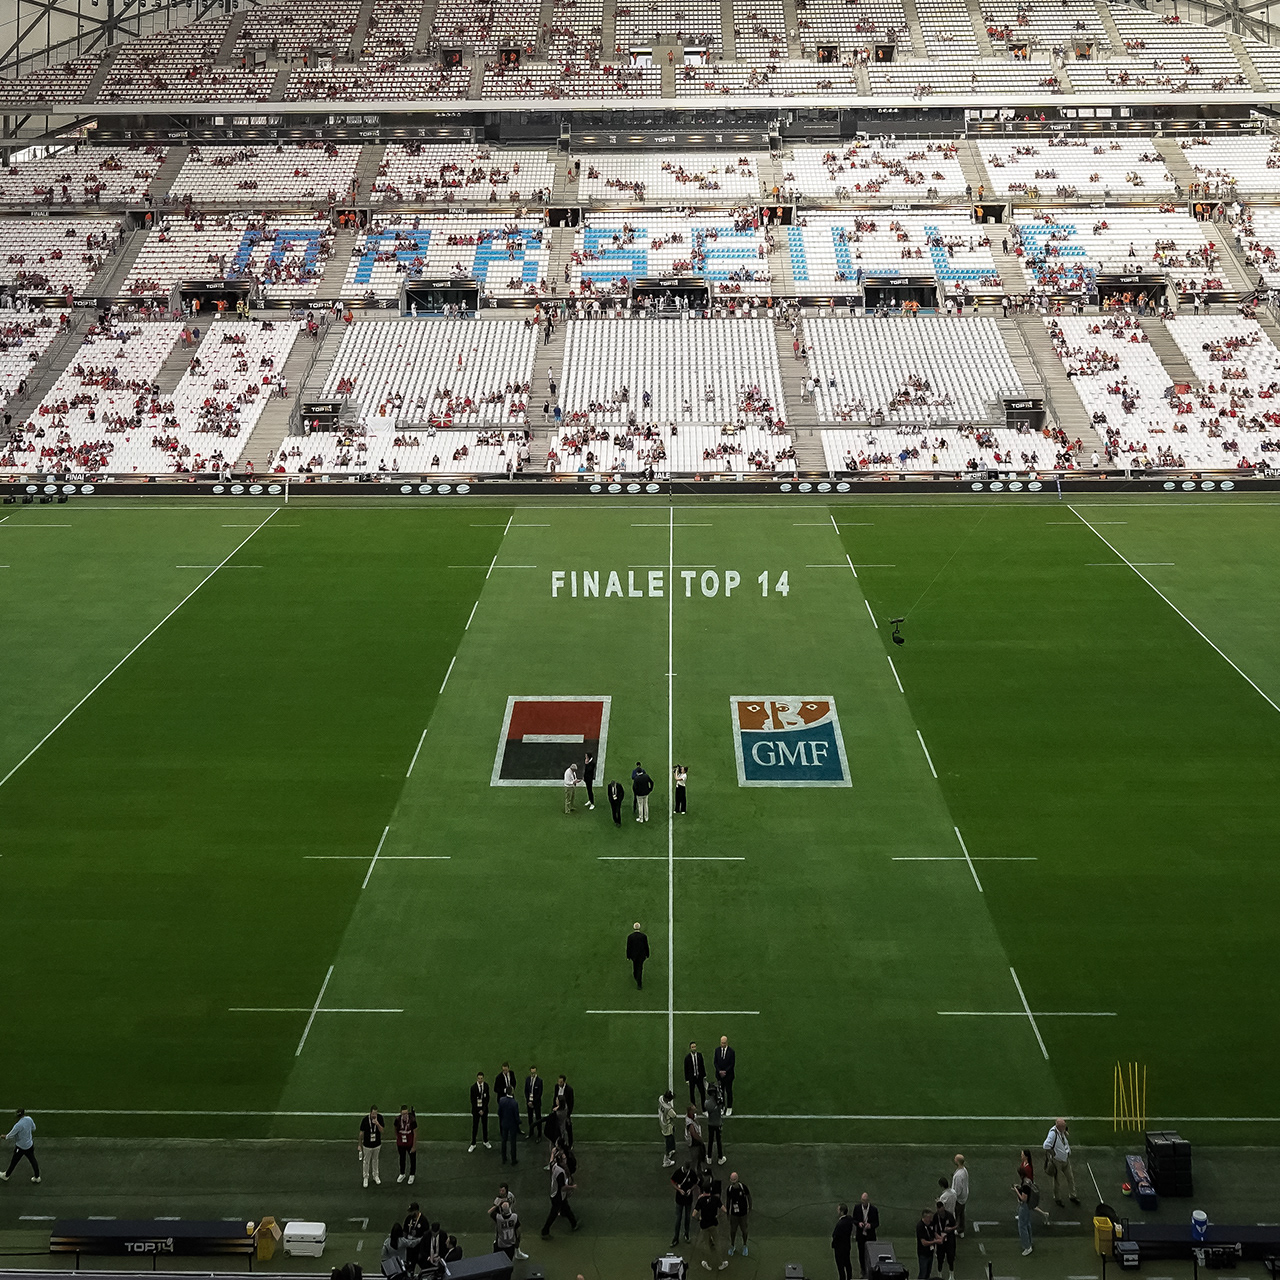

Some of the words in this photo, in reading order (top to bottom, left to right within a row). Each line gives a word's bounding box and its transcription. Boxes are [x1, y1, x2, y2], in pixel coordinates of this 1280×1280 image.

[551, 570, 665, 598] FINALE
[680, 569, 741, 598] TOP
[758, 570, 790, 597] 14
[751, 740, 829, 767] GMF
